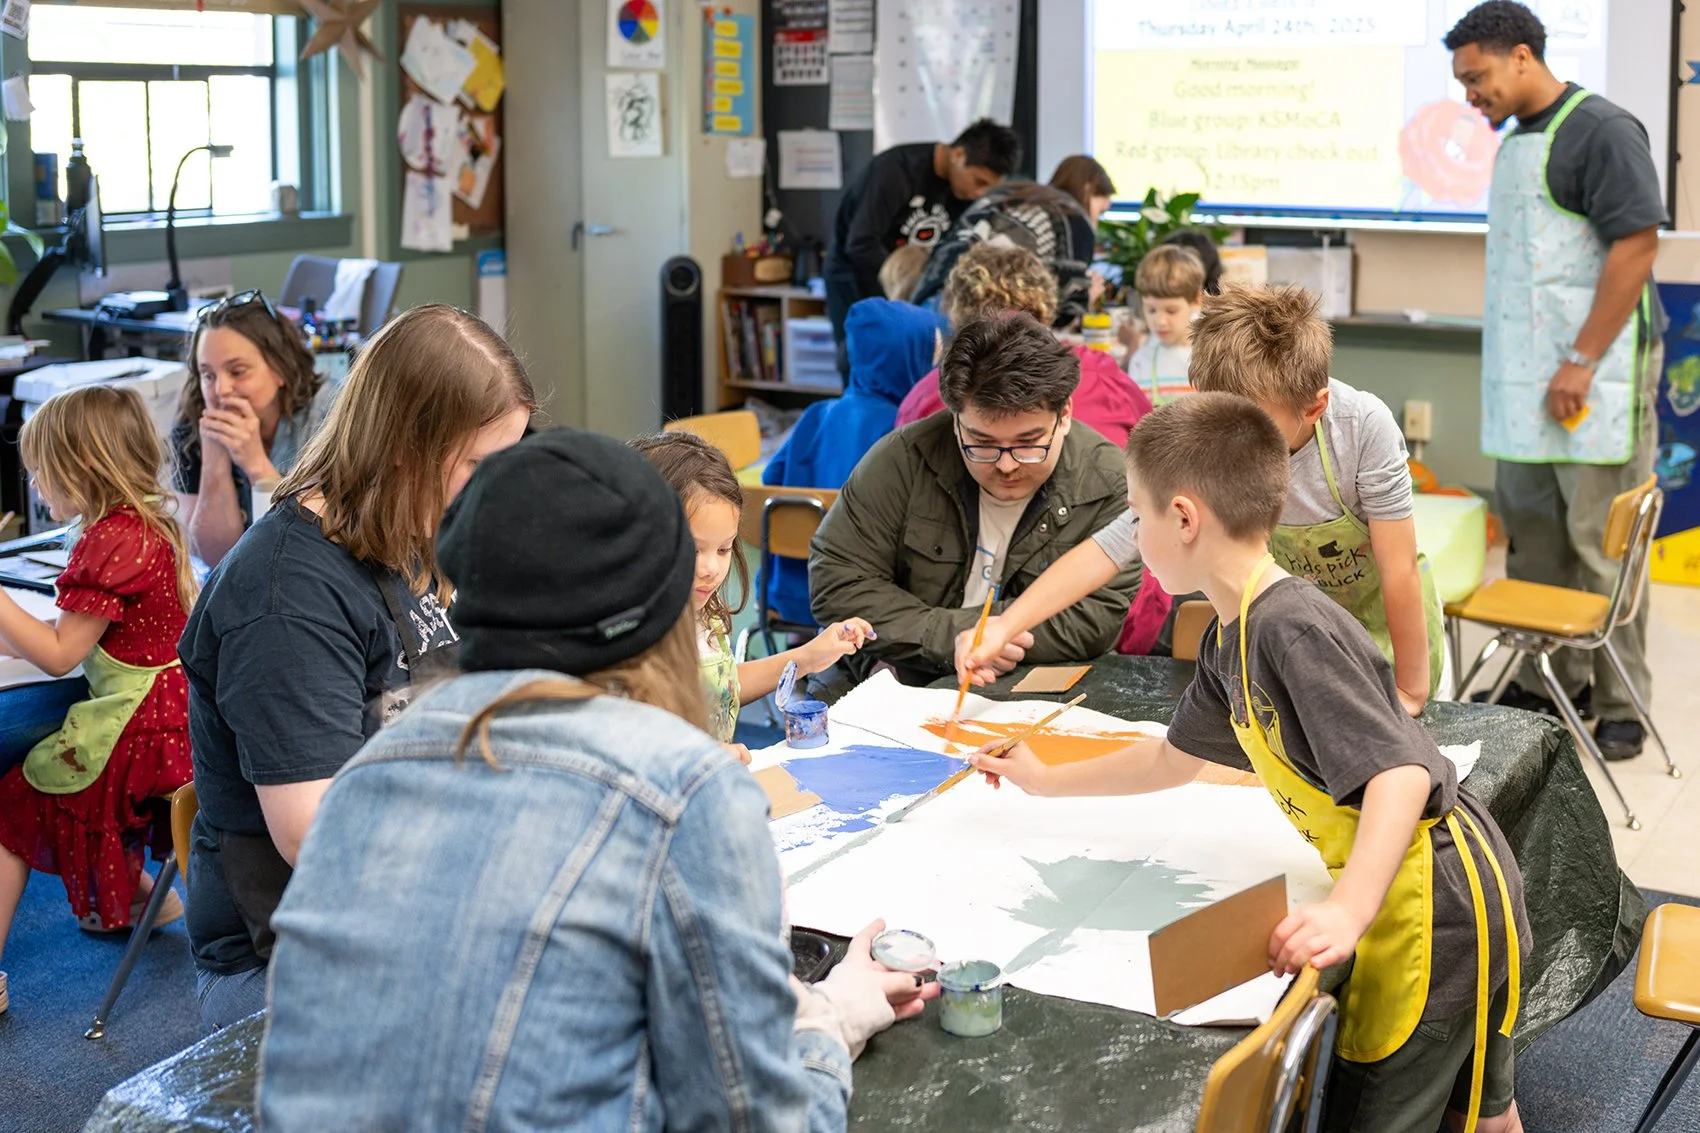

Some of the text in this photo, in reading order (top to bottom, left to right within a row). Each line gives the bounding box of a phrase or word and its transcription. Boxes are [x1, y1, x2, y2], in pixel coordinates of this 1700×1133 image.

[1138, 19, 1216, 40] Thursday
[1223, 18, 1265, 38] April
[1328, 17, 1376, 34] 2025
[1174, 79, 1221, 98] Good
[1148, 110, 1186, 129] Blue
[1115, 140, 1148, 159] Red
[1216, 141, 1281, 164] Library
[1285, 141, 1339, 161] check
[1345, 144, 1379, 161] out
